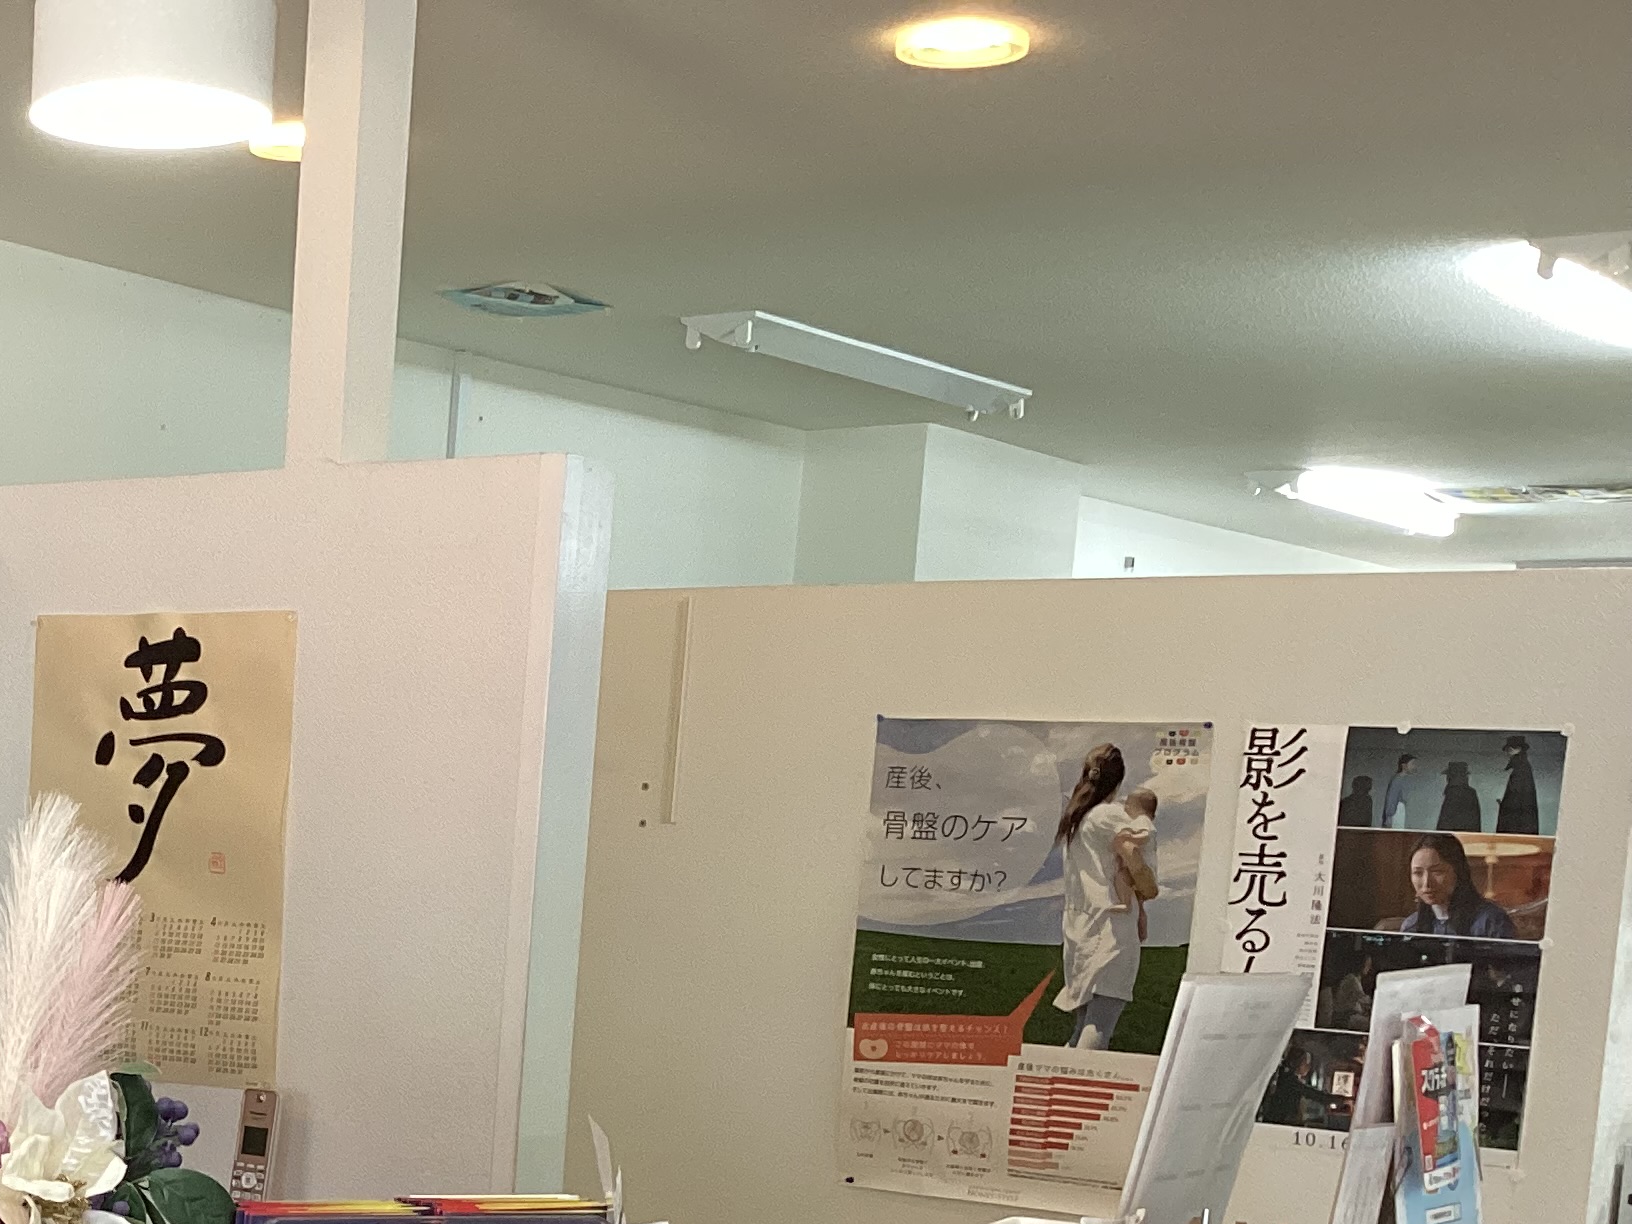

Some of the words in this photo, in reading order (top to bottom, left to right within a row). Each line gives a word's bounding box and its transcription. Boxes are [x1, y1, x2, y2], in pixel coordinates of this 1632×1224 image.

[94, 627, 226, 884] 夢
[886, 764, 943, 791] 産後、
[883, 811, 1028, 843] 骨盤のケア
[1228, 727, 1308, 973] 影を売る
